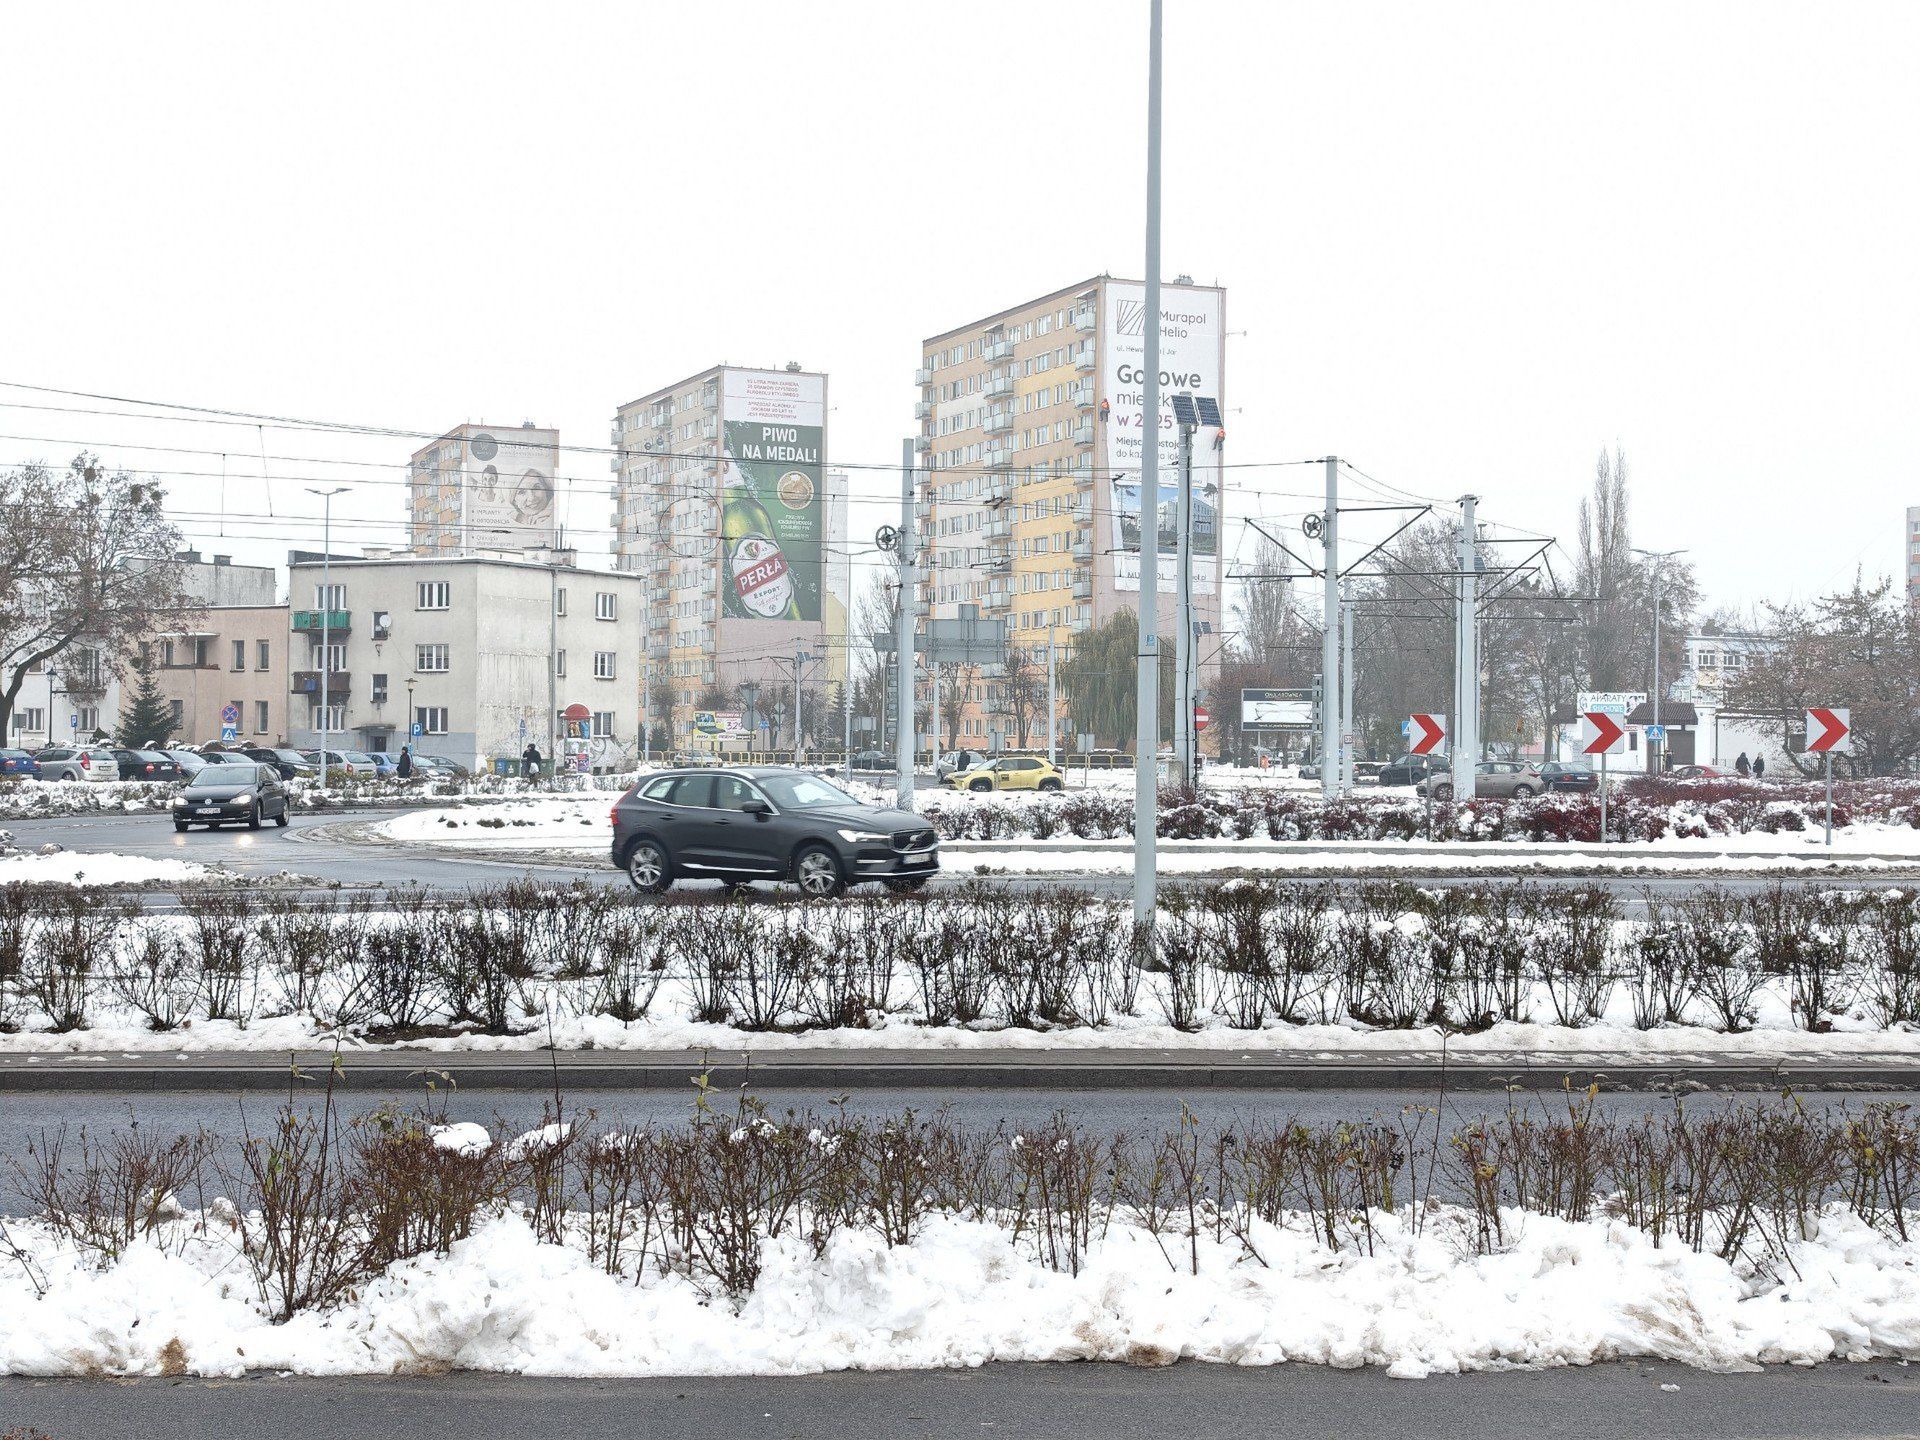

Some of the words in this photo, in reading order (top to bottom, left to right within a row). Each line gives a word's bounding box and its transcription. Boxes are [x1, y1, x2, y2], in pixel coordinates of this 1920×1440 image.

[1159, 311, 1206, 325] Murapol
[1159, 327, 1188, 338] Helio
[1117, 364, 1202, 389] Goowe
[1117, 415, 1129, 427] w
[762, 427, 797, 442] PIWO
[1116, 437, 1143, 447] Miejsc
[743, 444, 762, 459] NA
[766, 446, 817, 462] MEDAL!
[1116, 449, 1127, 458] do
[740, 557, 783, 592] PERŁA
[1591, 694, 1626, 703] APARATY
[414, 725, 420, 735] P
